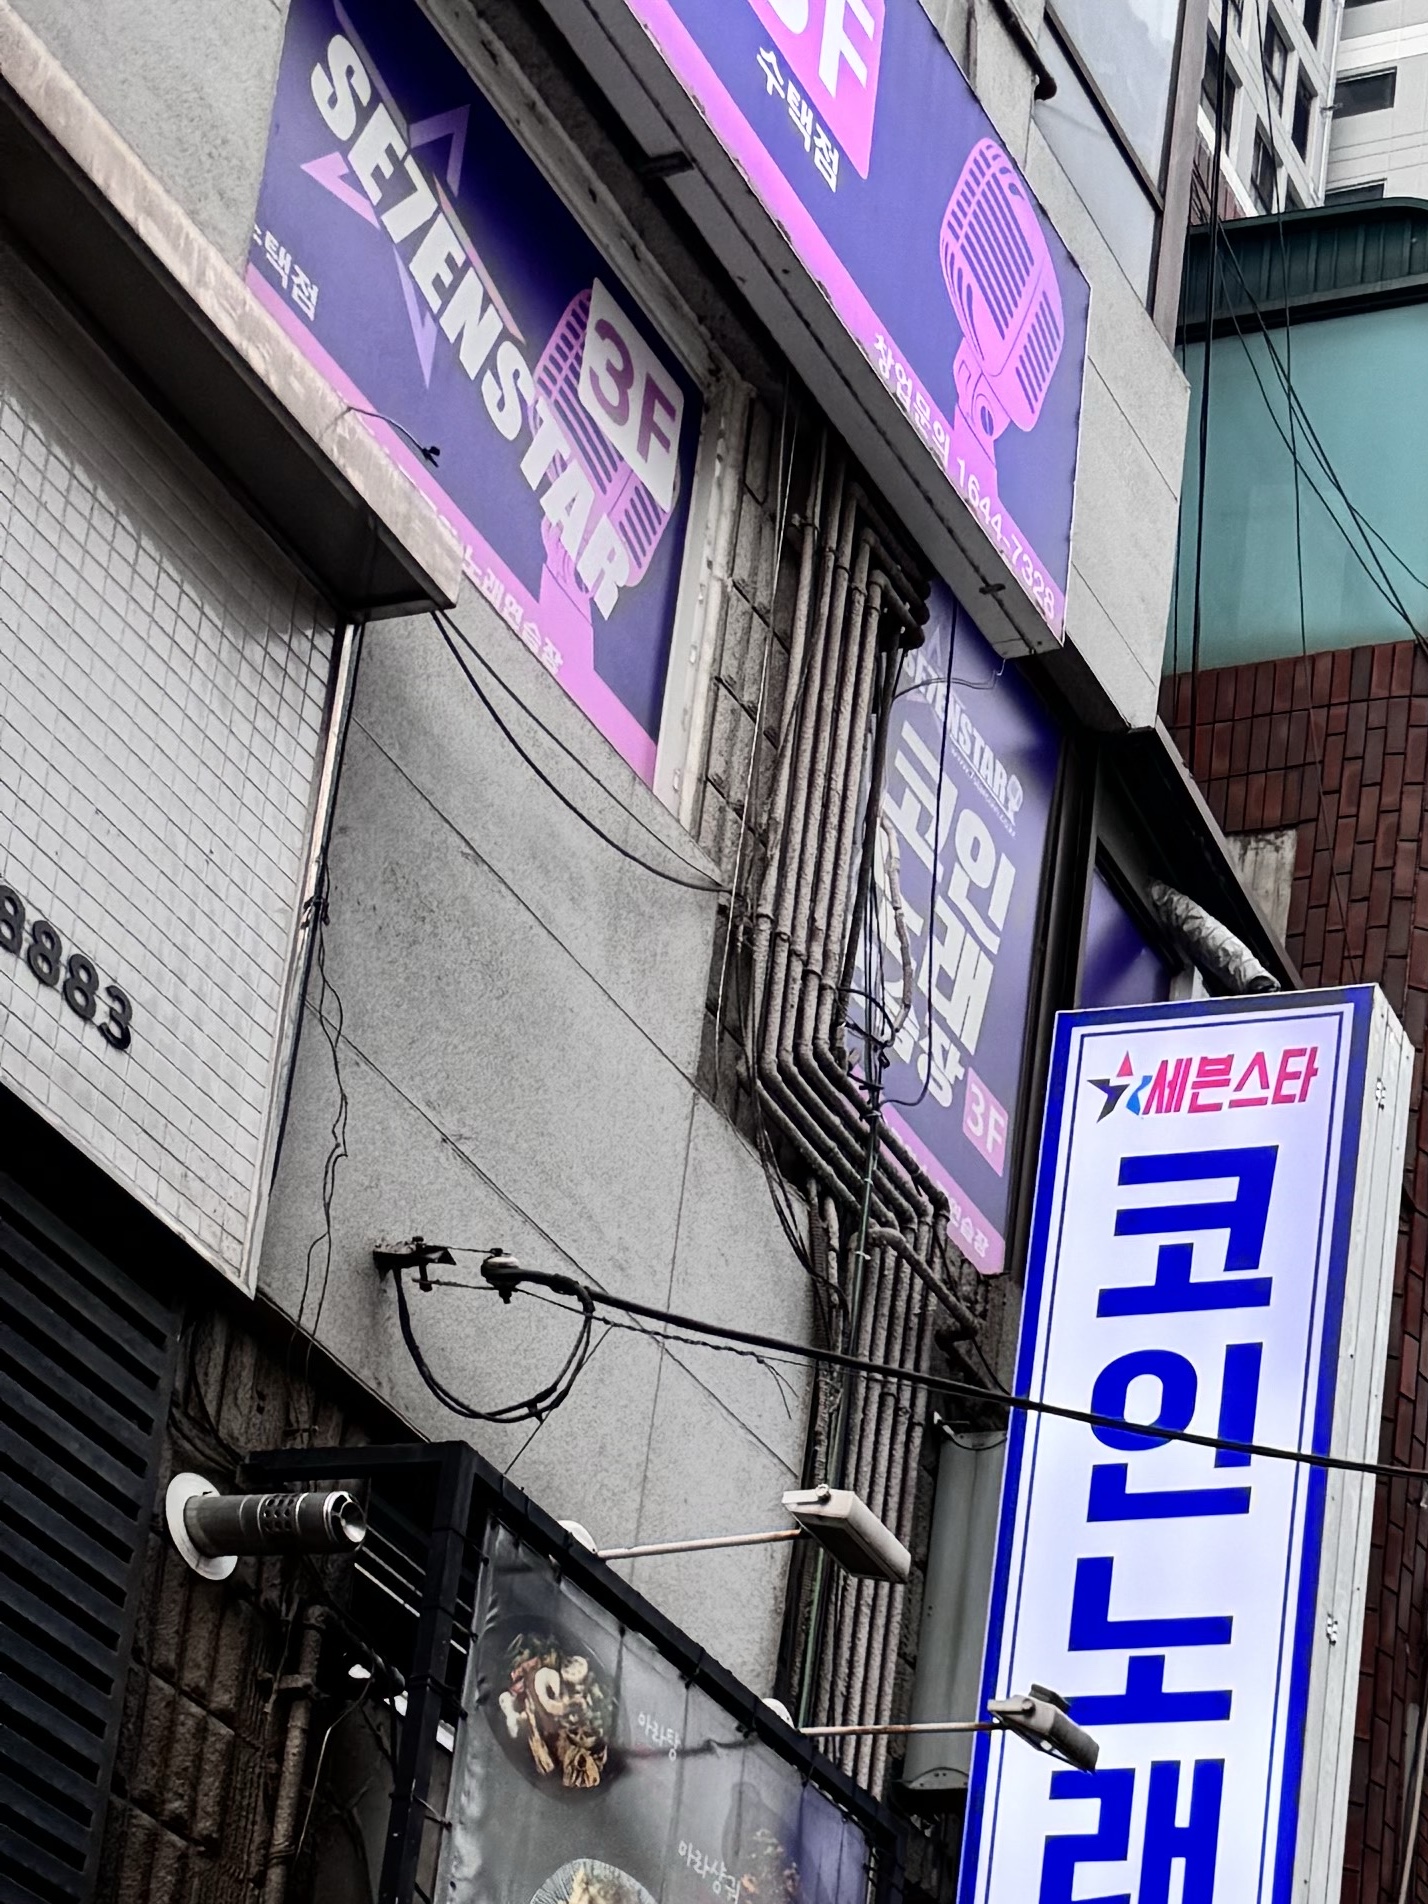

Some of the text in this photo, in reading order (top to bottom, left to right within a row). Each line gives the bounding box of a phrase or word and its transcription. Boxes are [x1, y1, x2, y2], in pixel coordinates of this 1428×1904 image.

[757, 47, 839, 192] 수택점
[254, 223, 320, 322] 택점
[587, 318, 681, 462] 3F
[874, 333, 1054, 620] 창업문의 1644-7328
[881, 719, 1016, 953] 코인
[966, 1083, 1005, 1154] 3F
[1145, 1045, 1320, 1117] 세븐스타
